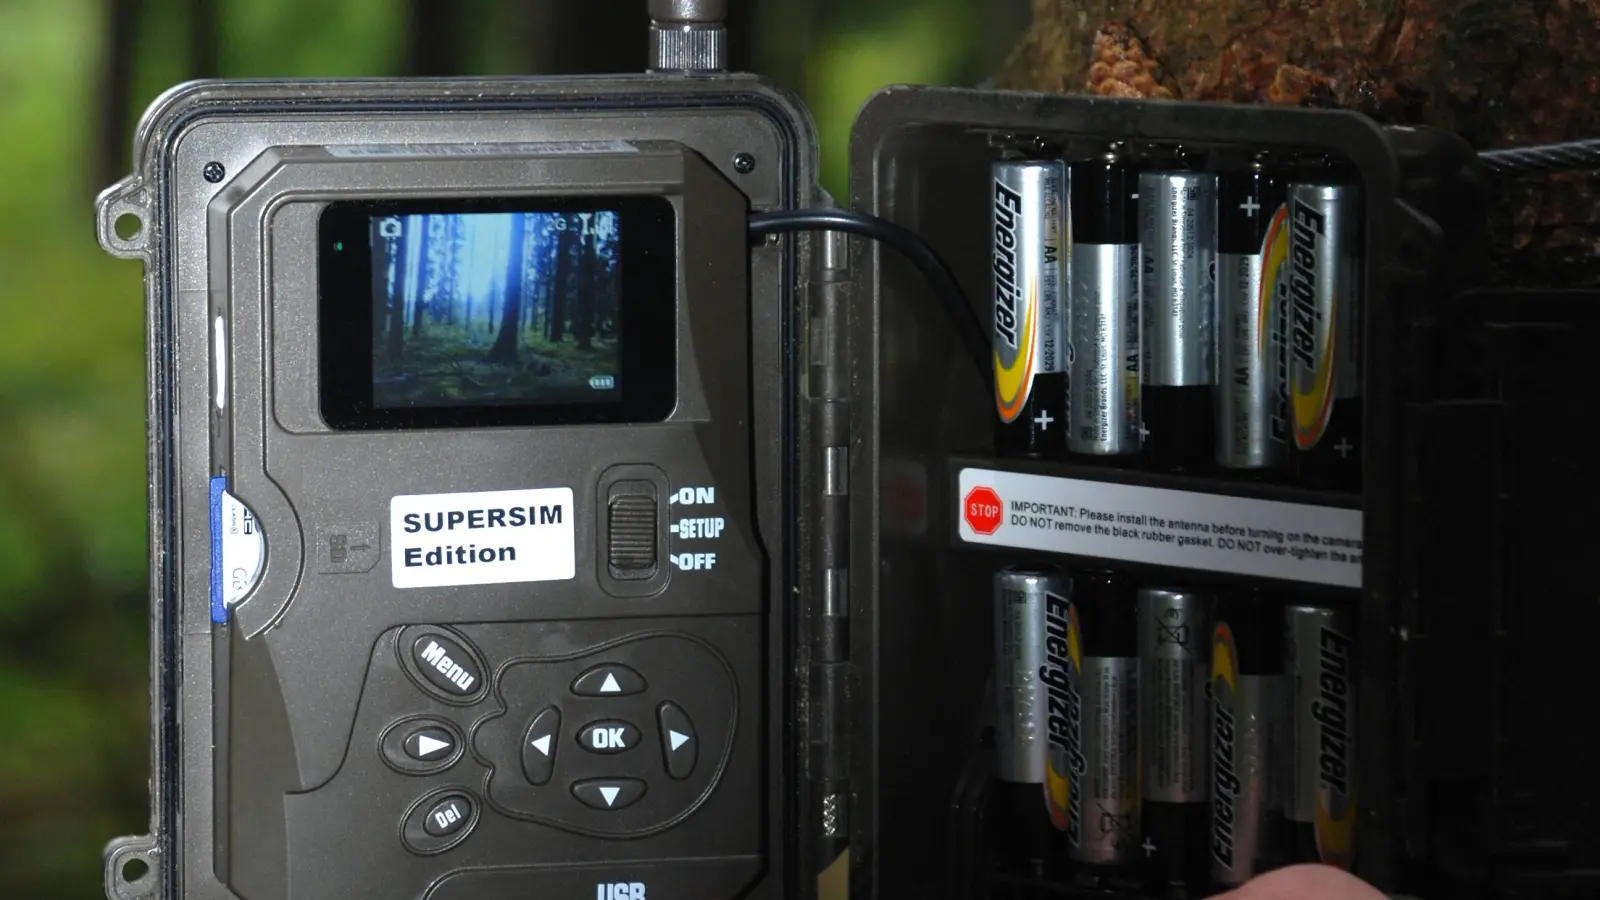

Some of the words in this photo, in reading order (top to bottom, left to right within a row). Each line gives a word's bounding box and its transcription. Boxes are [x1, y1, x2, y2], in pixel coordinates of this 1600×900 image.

[993, 178, 1022, 350] Energizer
[1044, 245, 1058, 264] AA
[1291, 200, 1325, 369] Energizer
[1044, 339, 1055, 372] 12-2029
[1126, 354, 1138, 373] AA
[1234, 367, 1249, 386] AA
[1100, 411, 1108, 441] Energizer
[678, 487, 715, 504] ON
[403, 504, 562, 533] SUPERSIM
[970, 502, 999, 519] STOP
[1010, 501, 1078, 519] IMPORTANT:
[1080, 508, 1115, 523] Please
[1117, 512, 1148, 526] install
[1150, 516, 1166, 528] the
[1168, 519, 1210, 533] antenna
[1212, 521, 1245, 537] before
[1287, 532, 1301, 542] on
[1302, 532, 1319, 544] the
[679, 517, 725, 539] SETUP
[1011, 514, 1028, 526] DO
[1030, 517, 1053, 529] NOT
[1054, 521, 1093, 534] remove
[1095, 524, 1110, 536] the
[1112, 526, 1140, 539] black
[1141, 530, 1176, 543] rubber
[1217, 537, 1236, 549] DO
[1237, 540, 1261, 552] NOT
[1330, 551, 1347, 563] the
[404, 545, 517, 568] Edition
[678, 552, 716, 571] OFF
[420, 640, 475, 692] Menu
[1040, 591, 1070, 750] Energizer
[1310, 627, 1351, 795] Energizer
[592, 728, 626, 748] OK
[1212, 701, 1239, 869] Energizer
[434, 804, 462, 829] Del
